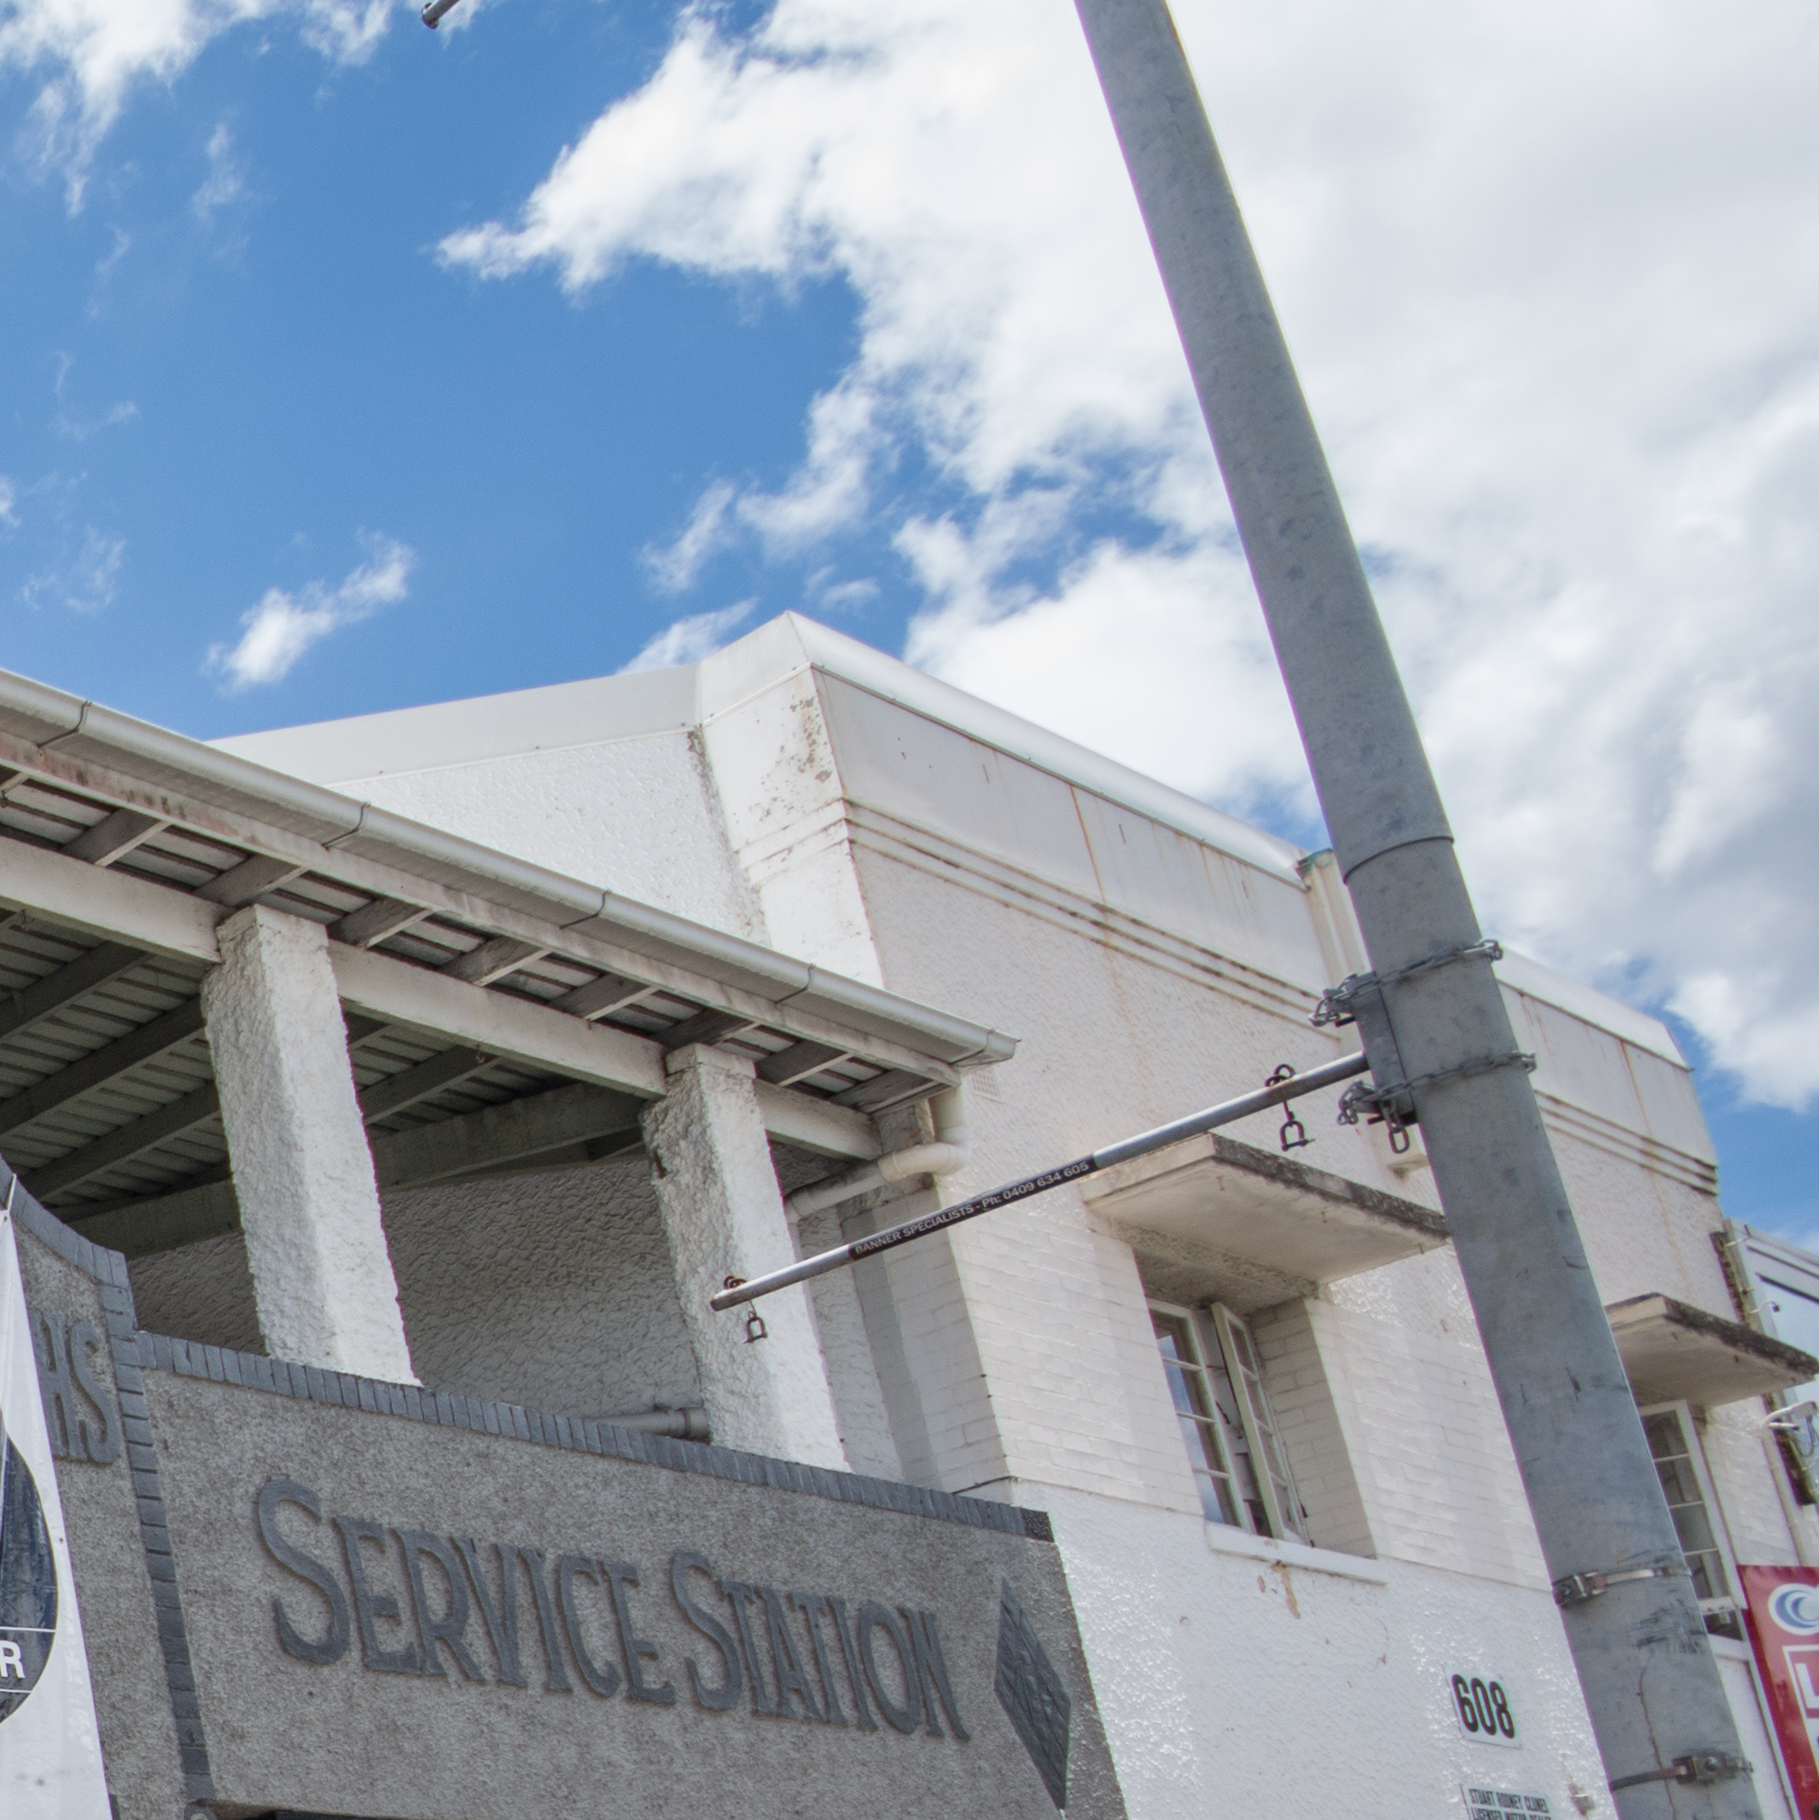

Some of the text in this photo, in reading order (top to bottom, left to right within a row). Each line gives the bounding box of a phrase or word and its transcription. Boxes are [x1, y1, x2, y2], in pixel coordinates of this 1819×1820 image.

[855, 1231, 902, 1255] BANNER
[902, 1204, 974, 1238] SPECIALISTS
[981, 1195, 1002, 1210] Ph:
[1002, 1182, 1035, 1200] 0409
[1036, 1172, 1062, 1187] 634
[1063, 1161, 1090, 1177] 605
[255, 1476, 971, 1742] SERVICE STATION
[1451, 1673, 1516, 1740] 608
